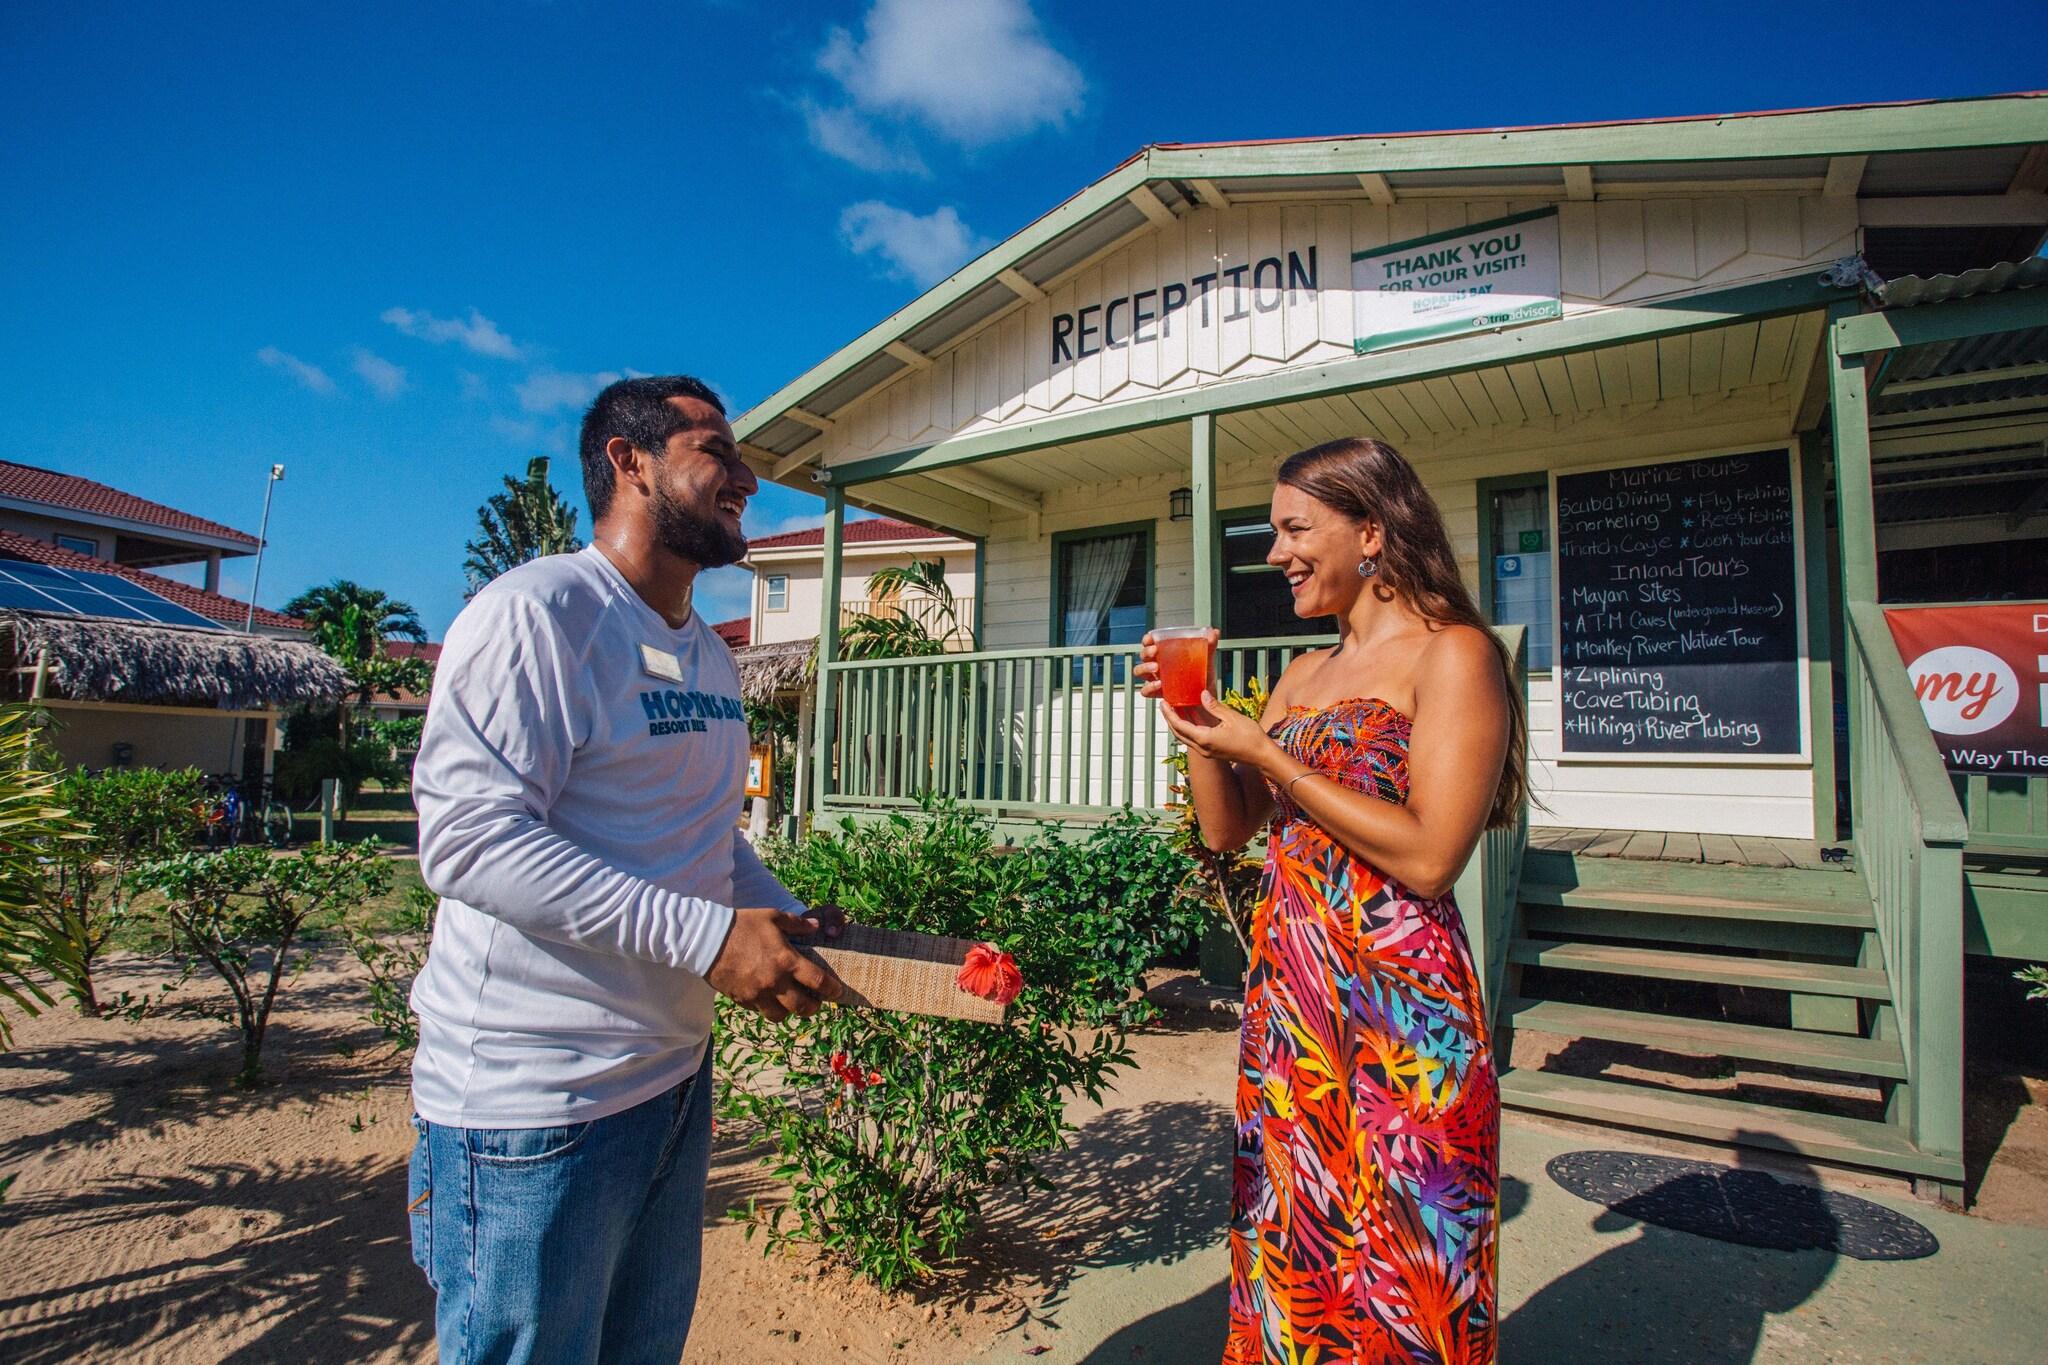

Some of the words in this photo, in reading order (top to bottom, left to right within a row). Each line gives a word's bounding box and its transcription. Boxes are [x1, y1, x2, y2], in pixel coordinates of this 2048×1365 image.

[1383, 246, 1463, 279] THANK
[1468, 233, 1521, 260] YOU
[1379, 279, 1413, 298] FOR
[1418, 267, 1468, 289] YOUR
[1473, 254, 1526, 275] VISIT!
[1052, 246, 1317, 365] RECEPTION
[1412, 289, 1467, 310] HOPKINS
[1469, 284, 1494, 300] BAY
[1489, 305, 1550, 324] tripadvisor
[1609, 465, 1682, 489] Marine
[1688, 458, 1750, 478] Tours
[1559, 496, 1614, 517] Scuba
[1618, 490, 1672, 512] Diving
[1699, 489, 1733, 512] Fly
[1737, 484, 1791, 503] Fishing
[1559, 511, 1660, 534] Snorkeling
[1620, 534, 1673, 557] Caye
[1693, 528, 1732, 548] Cook
[1736, 530, 1764, 548] Your
[1609, 562, 1683, 581] Inland
[1685, 555, 1750, 578] Tours
[1573, 586, 1629, 613] Mayan
[1638, 581, 1682, 604] Sites
[1576, 638, 1632, 665] Monkey
[1632, 635, 1680, 656] River
[1681, 633, 1728, 654] Nature
[1727, 628, 1764, 647] Tour
[1575, 666, 1664, 691] Ziplining
[1573, 690, 1623, 710] Cave
[1623, 690, 1706, 725] Tubing
[1915, 671, 2004, 721] my
[650, 719, 690, 737] RESORT
[1578, 714, 1635, 745] Hiking
[1645, 716, 1690, 740] River
[1692, 713, 1761, 746] Tubing
[1951, 749, 2003, 769] Way
